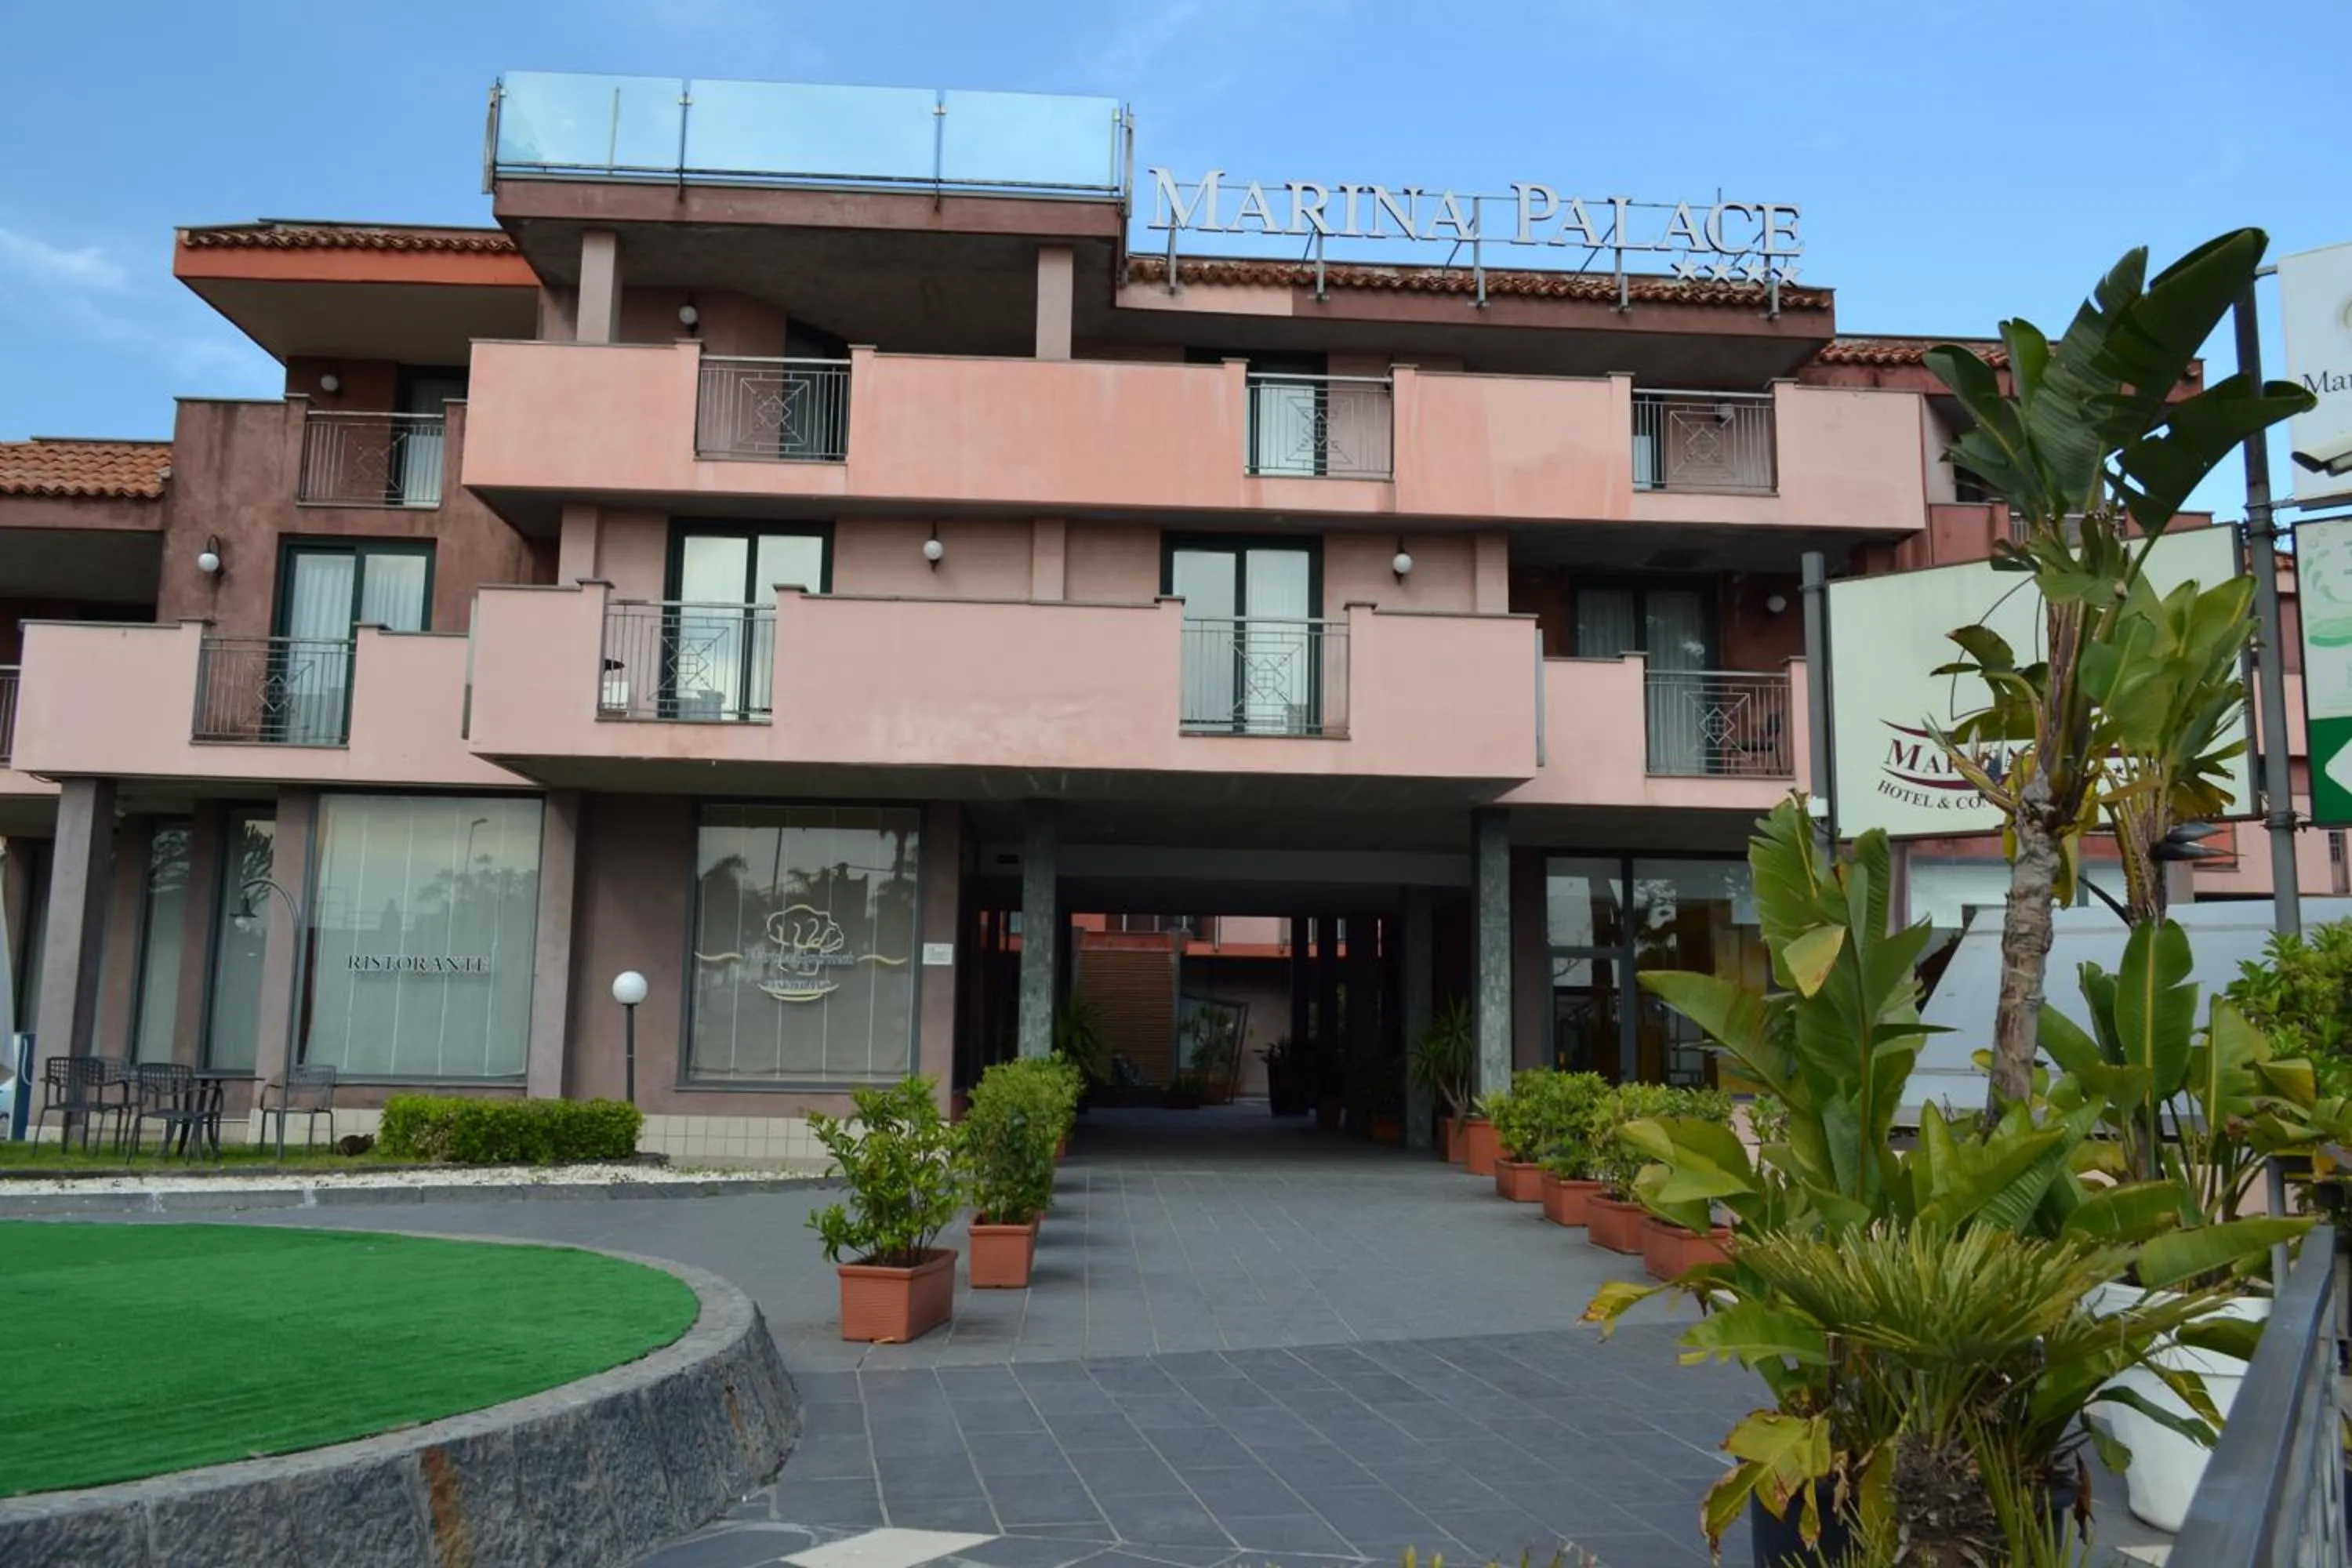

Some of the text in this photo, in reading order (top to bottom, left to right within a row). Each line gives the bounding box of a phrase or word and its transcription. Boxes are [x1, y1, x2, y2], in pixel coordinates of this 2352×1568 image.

[1148, 167, 1803, 257] MARINA PALACE
[1878, 779, 1987, 810] HOTEL & CO
